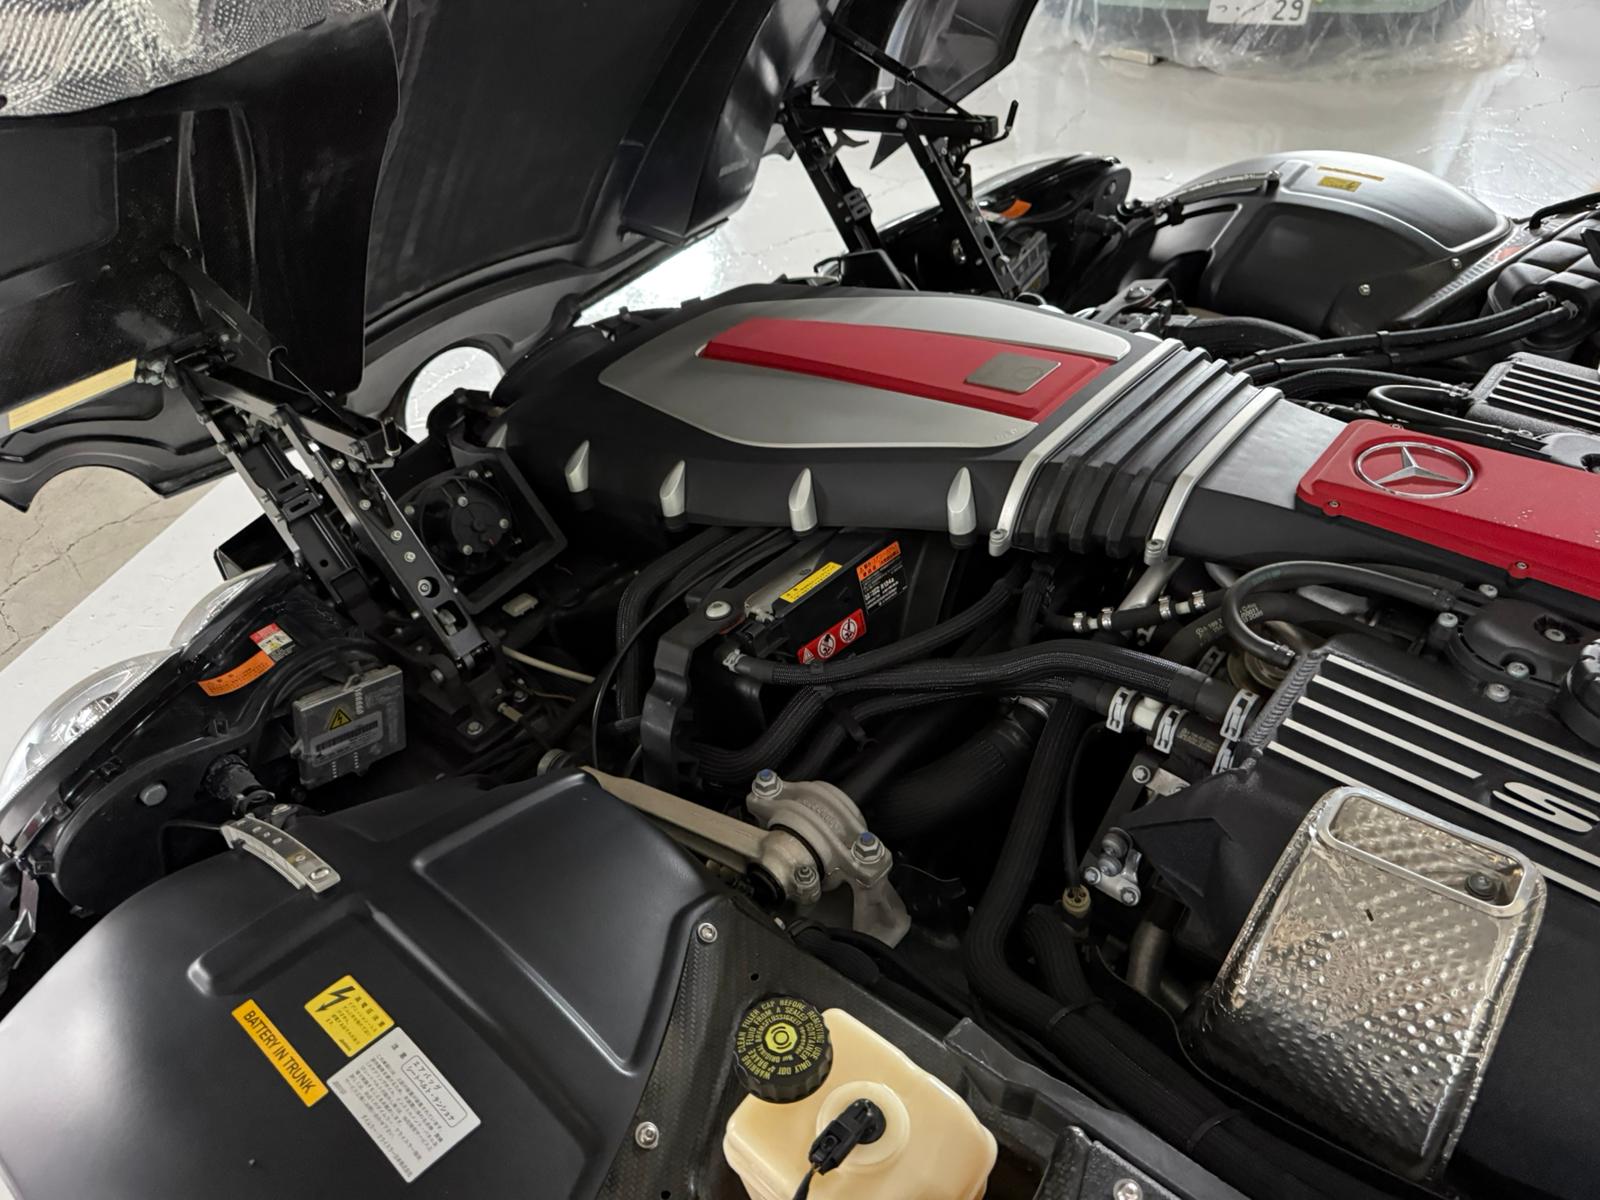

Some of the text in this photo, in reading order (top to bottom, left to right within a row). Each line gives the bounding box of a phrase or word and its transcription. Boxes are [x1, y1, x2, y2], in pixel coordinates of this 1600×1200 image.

[1271, 0, 1304, 21] 29
[761, 1000, 775, 1010] CAP
[779, 1000, 806, 1010] BEFORE
[743, 1009, 760, 1028] FILLER
[753, 1010, 772, 1025] FROM
[785, 1007, 808, 1021] SEALED
[737, 1032, 746, 1053] CLEAN
[746, 1027, 756, 1045] FLUID
[800, 1023, 815, 1060] CONTAINER
[243, 1010, 318, 1095] BATTERY IN TRUNK
[748, 1049, 769, 1069] BRAKE
[811, 1046, 823, 1060] USE
[777, 1067, 792, 1075] DOT
[794, 1060, 812, 1073] ONLY
